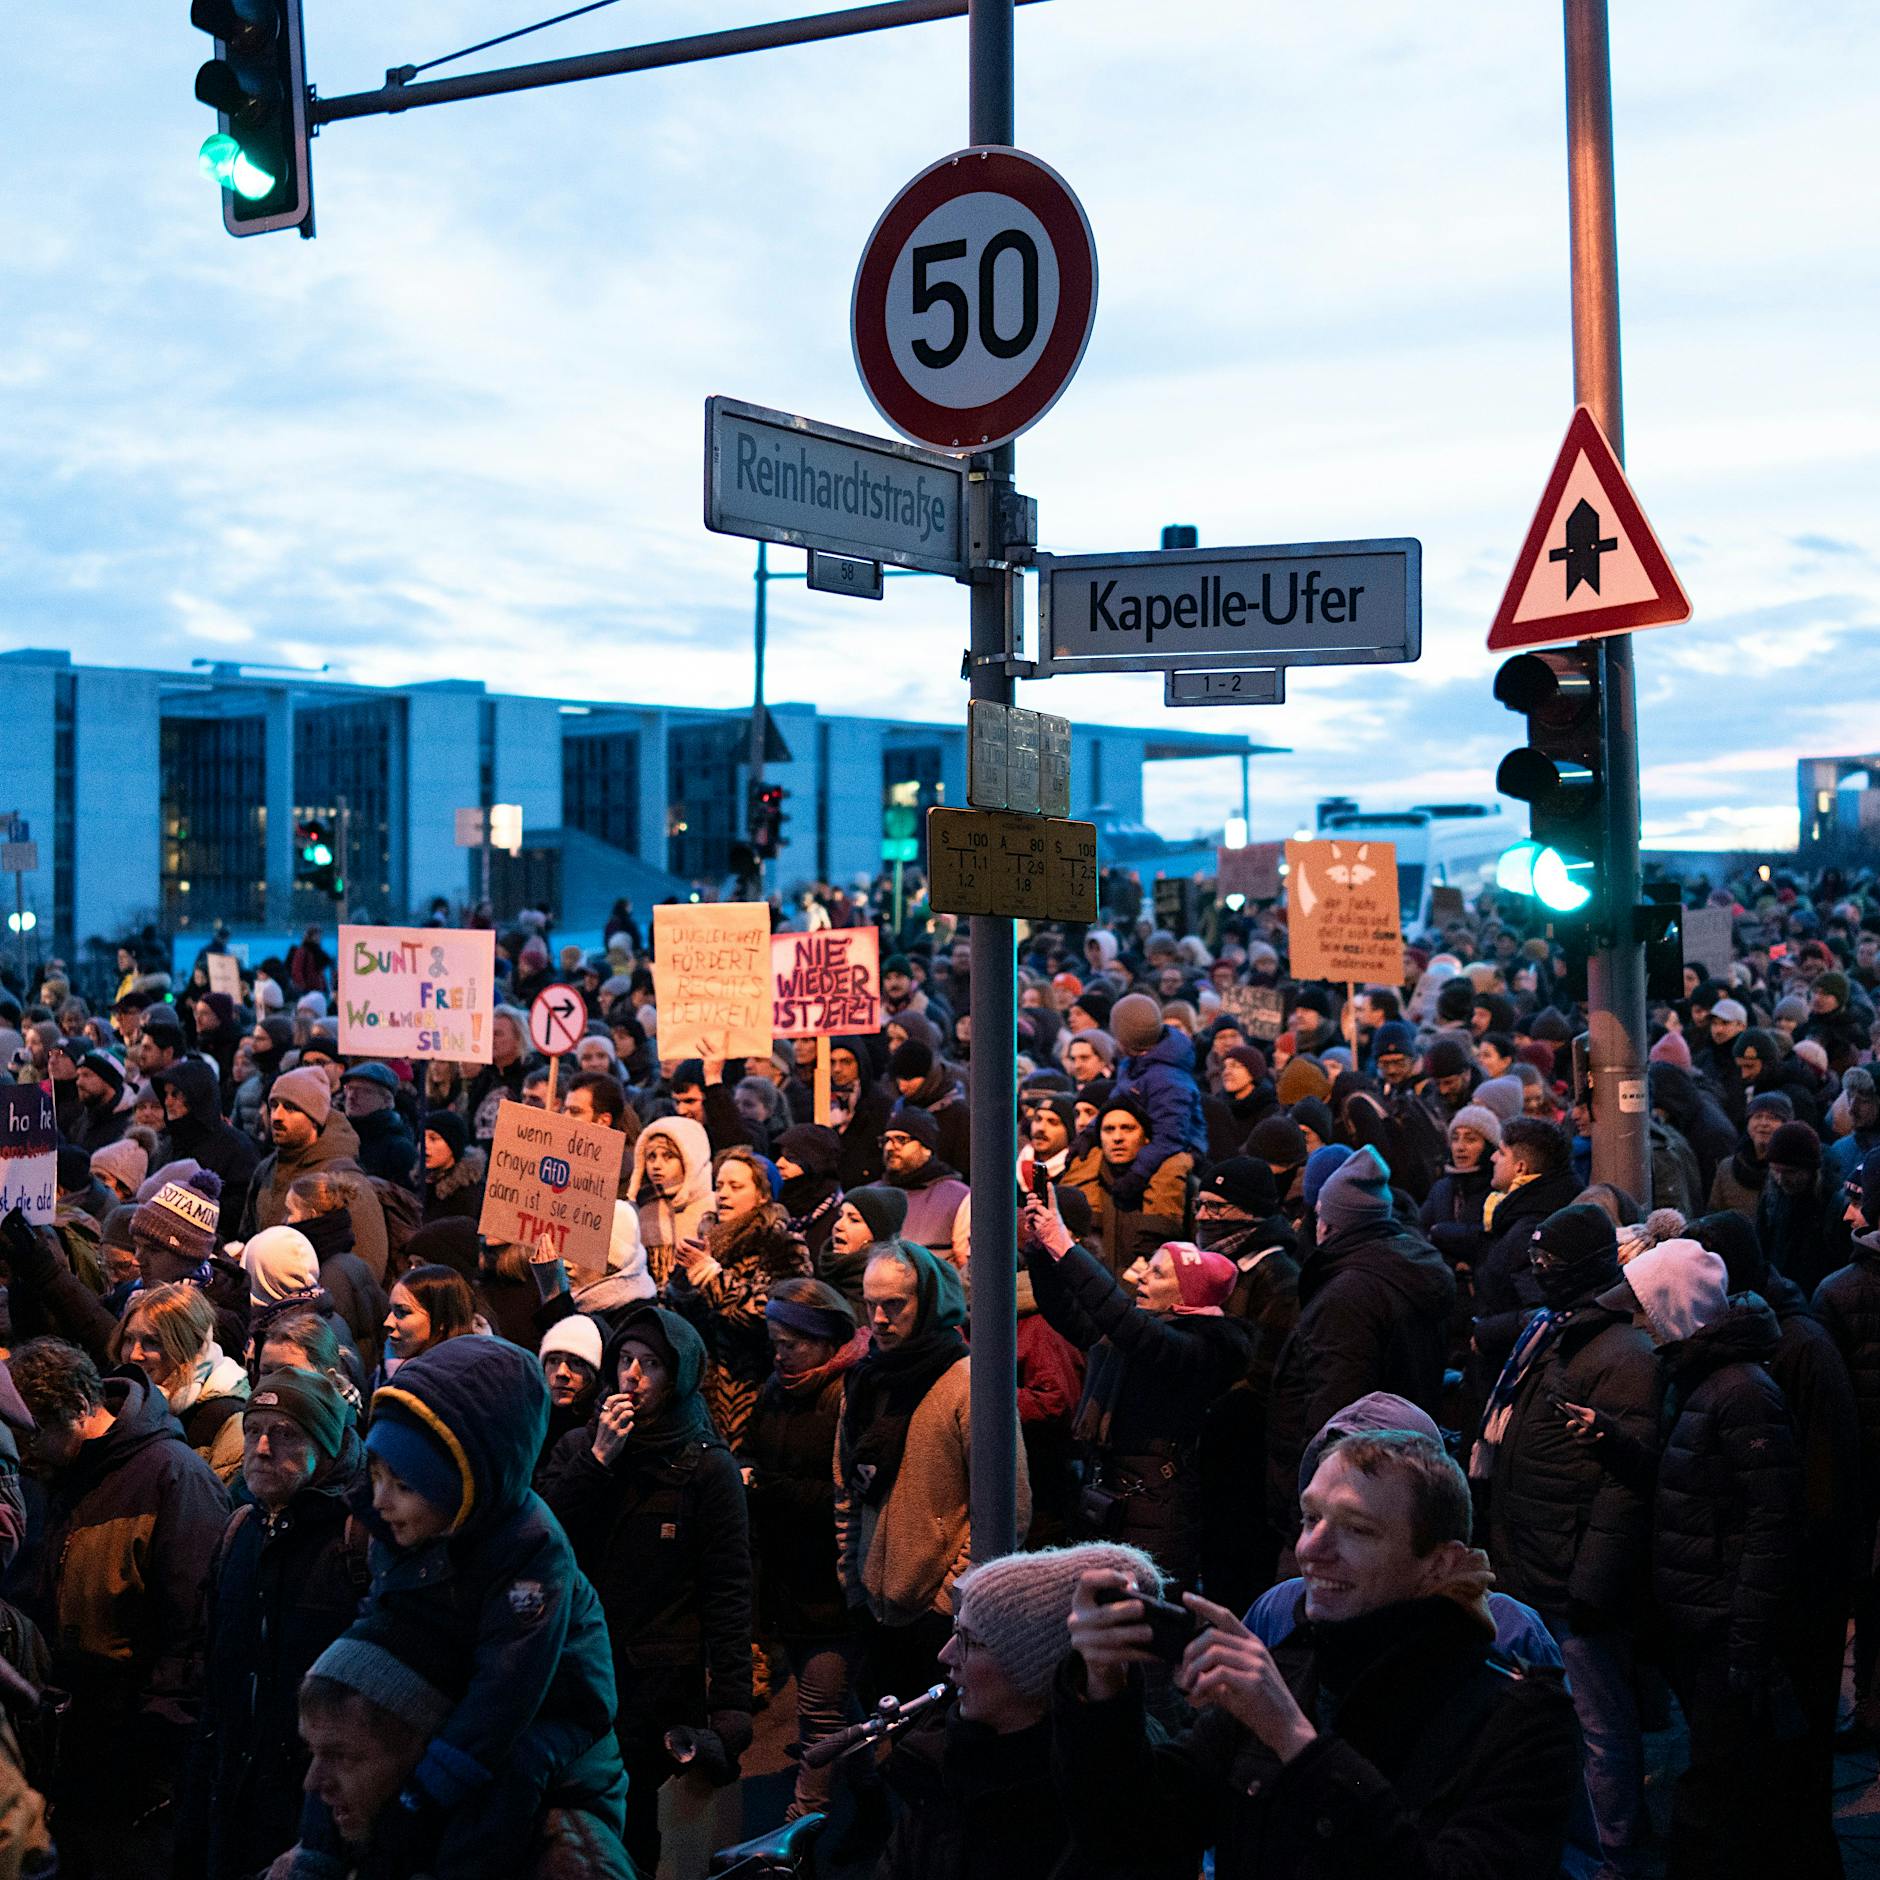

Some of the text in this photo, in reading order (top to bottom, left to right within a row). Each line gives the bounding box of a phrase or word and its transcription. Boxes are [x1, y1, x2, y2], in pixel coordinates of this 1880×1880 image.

[911, 229, 1039, 369] 50
[737, 433, 945, 540] Reinhardtstraße
[841, 563, 854, 580] 58
[1089, 572, 1365, 641] Kapelle-Ufer
[942, 831, 988, 847] S 100
[1001, 836, 1044, 852] A 80
[1078, 843, 1096, 857] 100
[354, 942, 448, 978] BUNT &
[672, 945, 759, 972] FÖRDERT
[795, 937, 852, 968] NIE
[777, 964, 873, 1000] WIEDER
[672, 1002, 760, 1028] DENKEN
[773, 997, 879, 1028] IST JETZT
[9, 1102, 30, 1132] ho
[517, 1125, 602, 1161] wenn deine
[497, 1150, 535, 1180] chaya
[541, 1159, 567, 1185] AfD
[489, 1179, 602, 1230] dann ist sie eine
